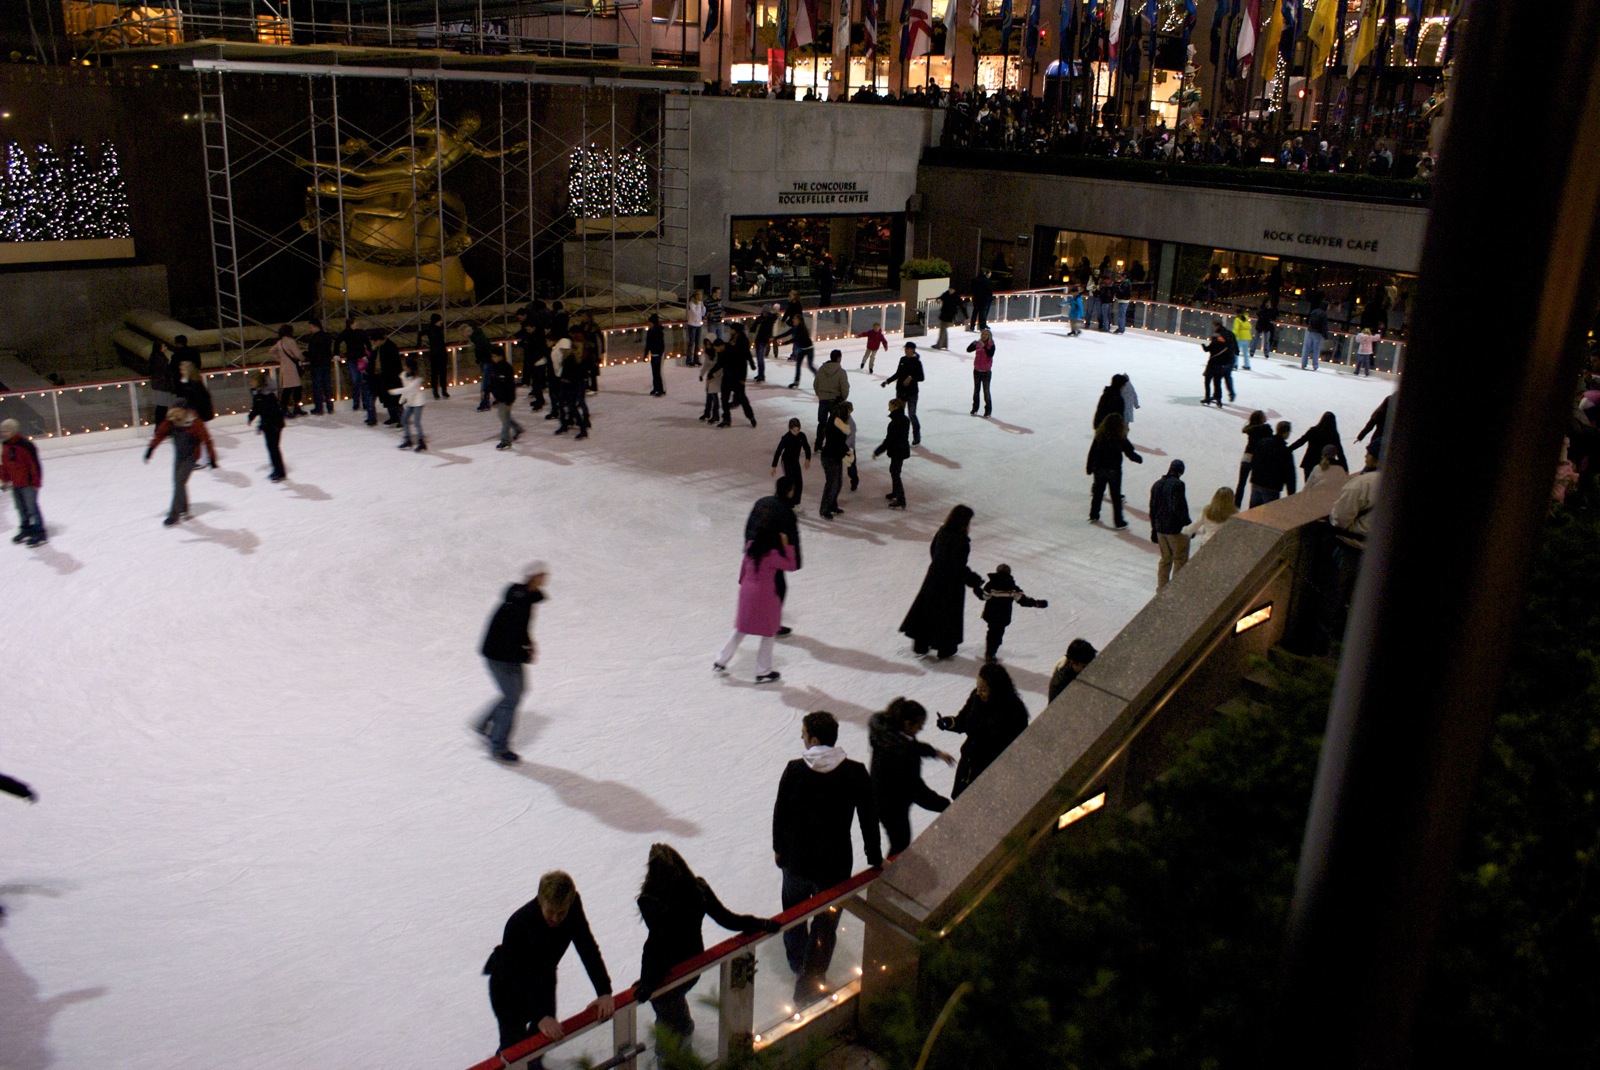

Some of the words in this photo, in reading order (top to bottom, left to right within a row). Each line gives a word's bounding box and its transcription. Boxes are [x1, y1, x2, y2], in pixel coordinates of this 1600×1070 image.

[793, 182, 808, 190] THE
[810, 182, 857, 190] CONCOURSE
[779, 195, 835, 204] ROCKEFELLER
[838, 194, 869, 203] CENTER
[1263, 230, 1293, 242] ROCK
[1297, 233, 1343, 248] CENTER
